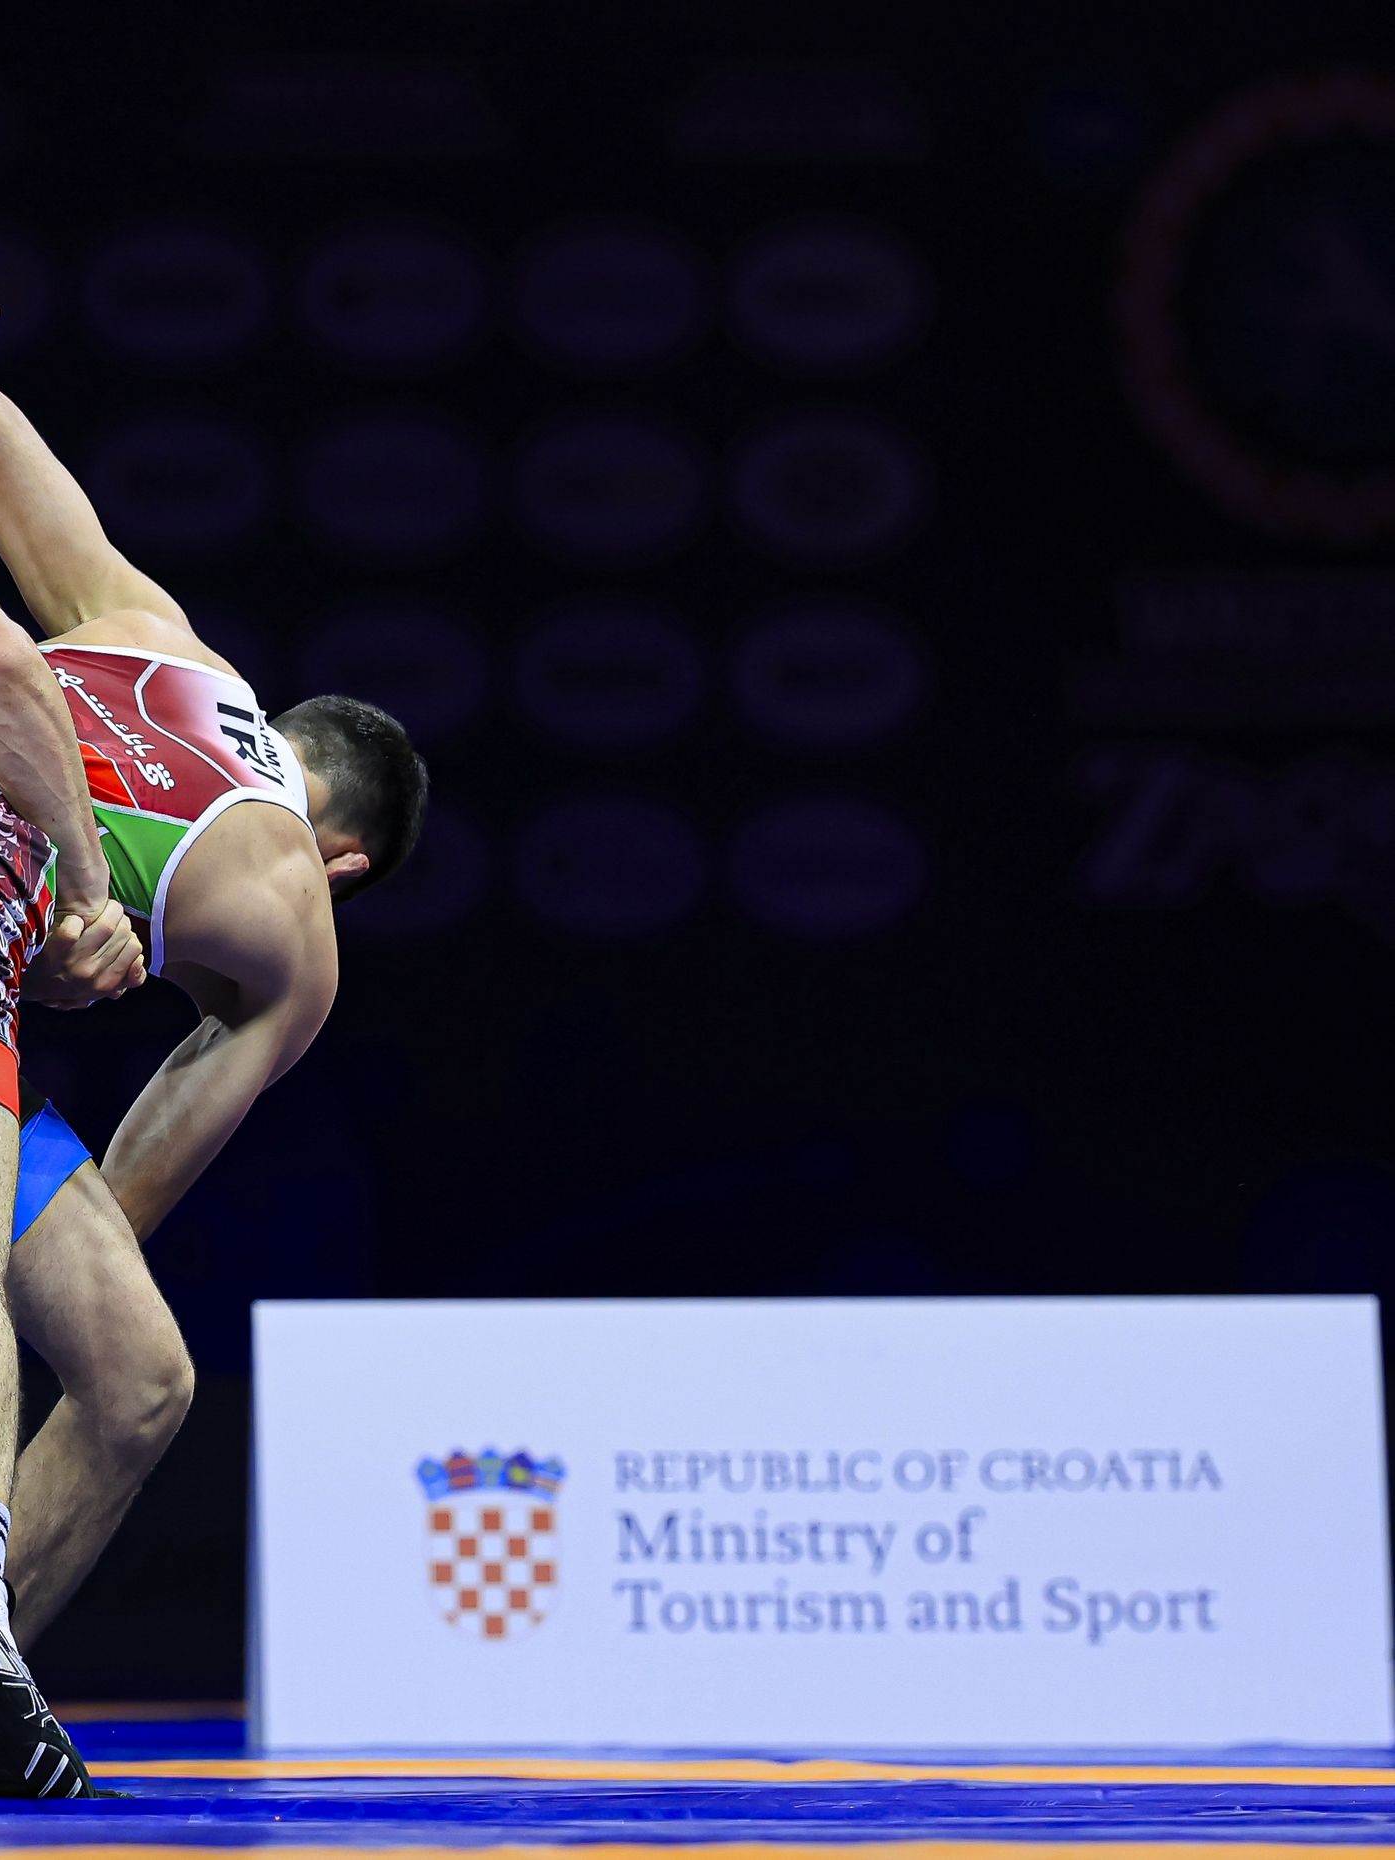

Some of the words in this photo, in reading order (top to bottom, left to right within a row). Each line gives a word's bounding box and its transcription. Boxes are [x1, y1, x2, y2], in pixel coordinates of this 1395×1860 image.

[216, 701, 286, 787] IRI
[614, 1449, 883, 1494] REPUBLIC
[891, 1449, 970, 1494] OF
[978, 1449, 1225, 1494] CROATIA
[615, 1507, 897, 1576] Ministry
[913, 1506, 987, 1565] of
[611, 1576, 889, 1634] Tourism
[906, 1575, 1025, 1634] and
[1042, 1576, 1220, 1647] Sport
